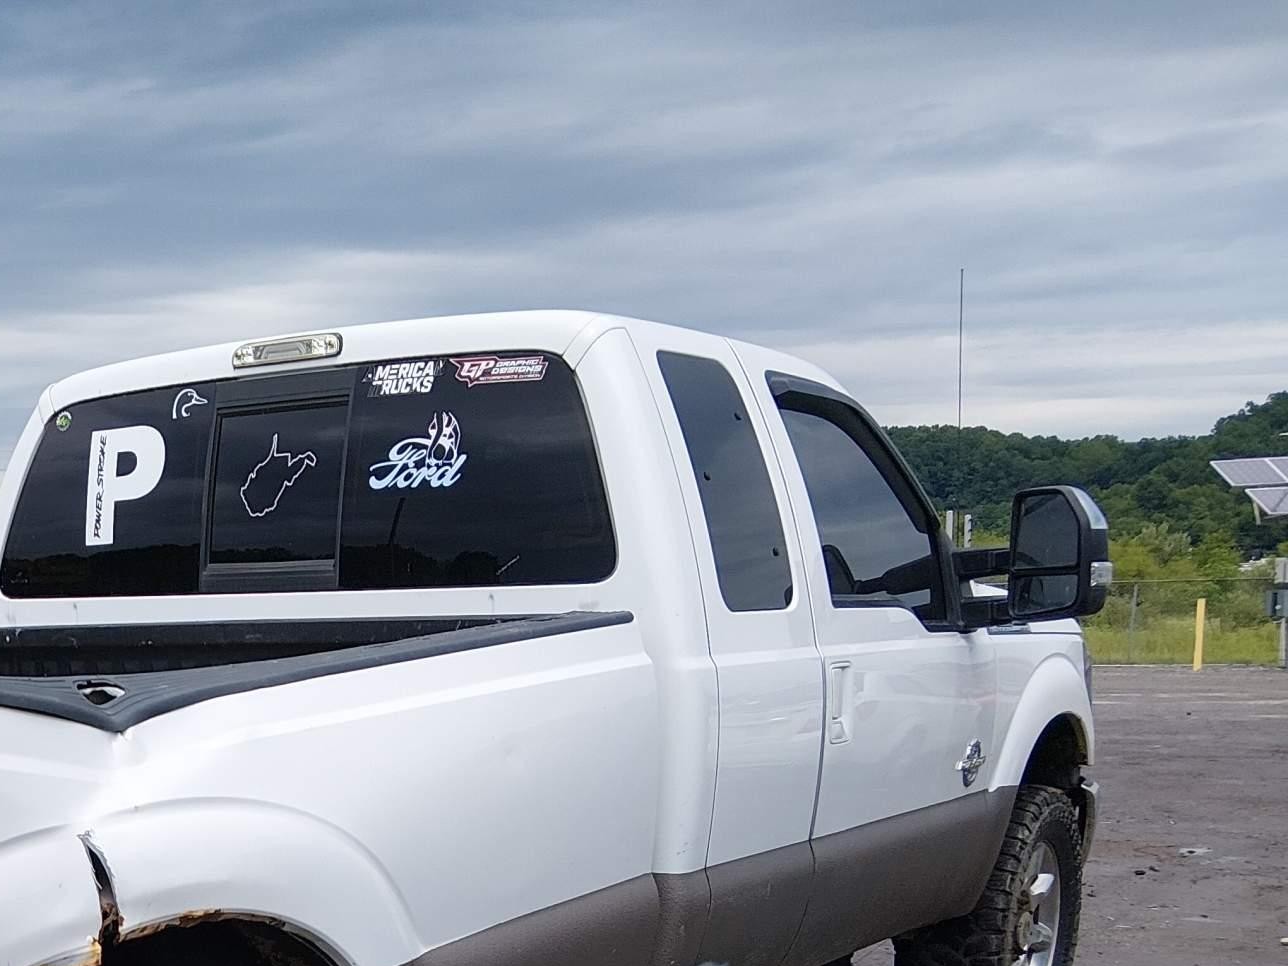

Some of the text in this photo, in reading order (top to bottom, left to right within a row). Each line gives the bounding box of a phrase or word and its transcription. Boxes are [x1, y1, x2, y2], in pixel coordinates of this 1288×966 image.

[372, 376, 434, 396] TRUCKS
[495, 359, 540, 368] GRAPHIC
[86, 425, 166, 546] P
[93, 434, 108, 539] POWER STROKE
[369, 437, 467, 490] Ford
